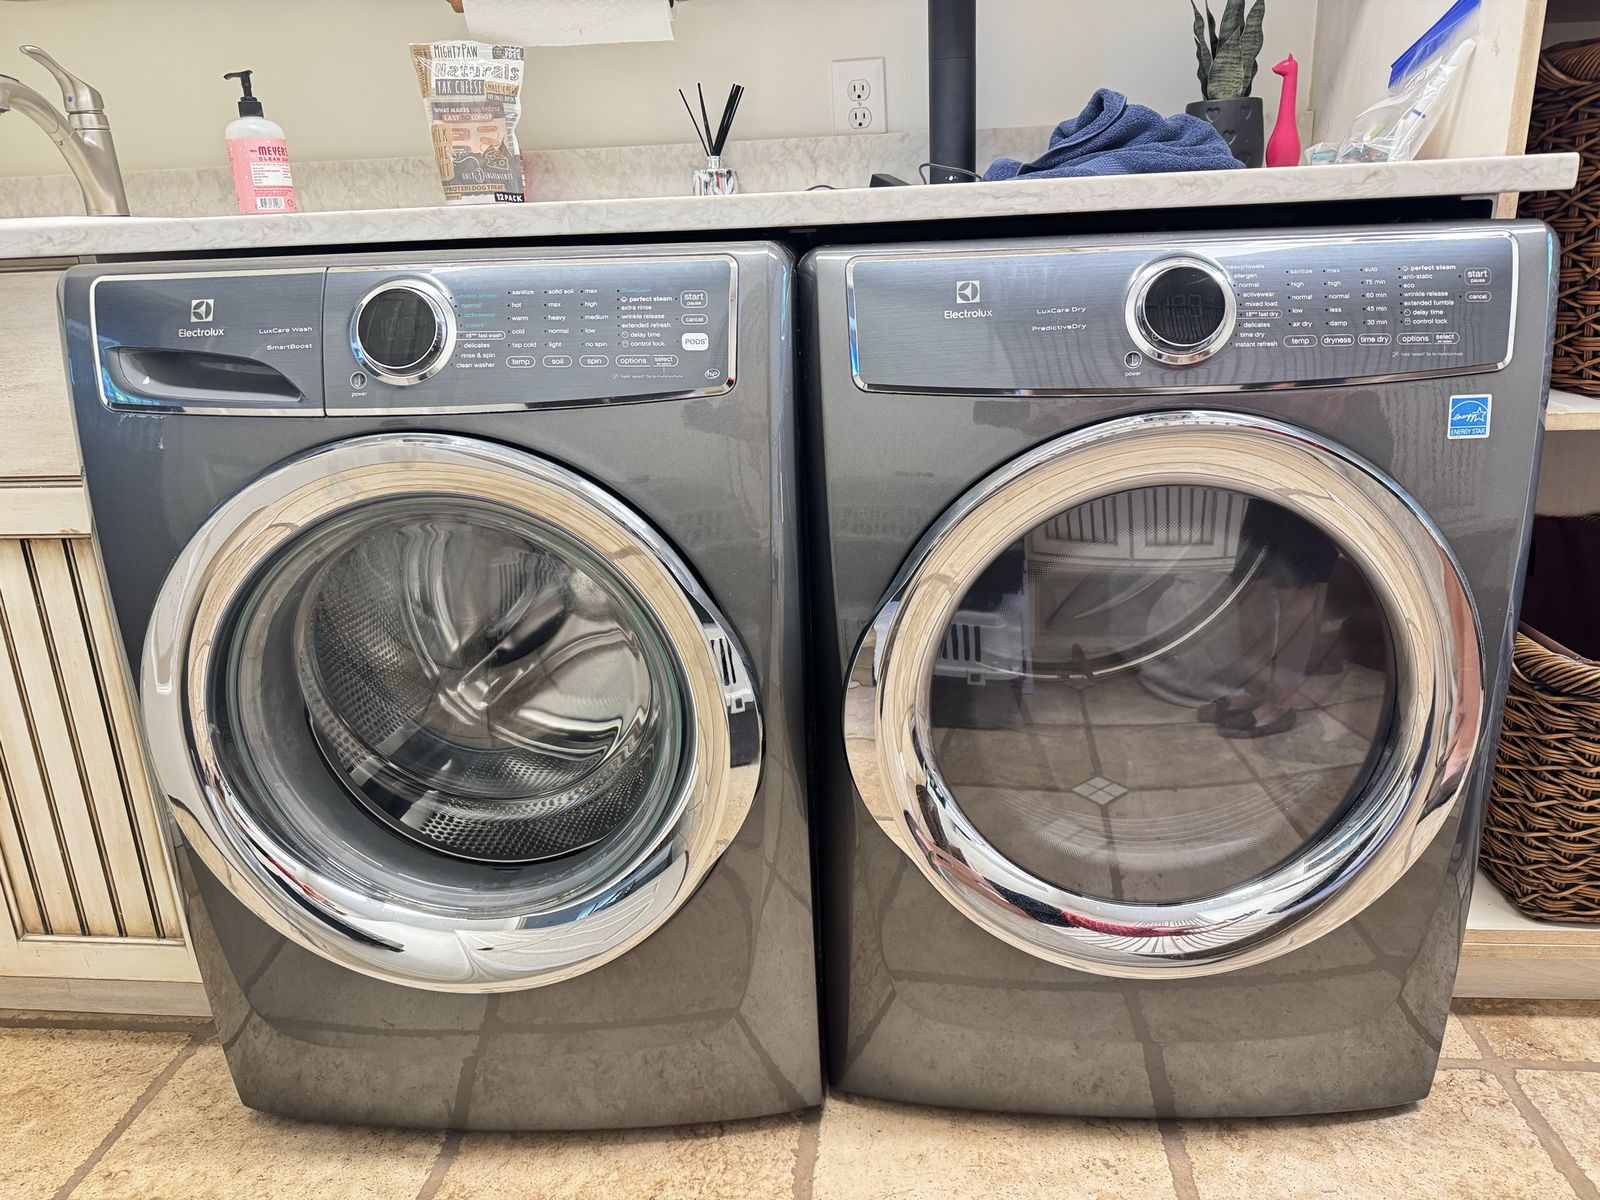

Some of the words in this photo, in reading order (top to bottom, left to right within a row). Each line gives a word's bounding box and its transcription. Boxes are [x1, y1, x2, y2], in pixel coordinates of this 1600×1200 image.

[437, 80, 452, 94] YAK
[455, 80, 483, 94] CHEESE
[1467, 269, 1488, 278] start
[684, 292, 704, 301] start
[585, 301, 598, 309] high
[944, 308, 993, 319] Electrolux
[1071, 306, 1087, 314] Dry
[1412, 309, 1429, 317] delay
[548, 314, 566, 322] heavy
[585, 313, 609, 321] medium
[1031, 323, 1087, 332] PredictiveDry
[1302, 320, 1313, 328] dry
[1329, 320, 1348, 328] damp
[178, 328, 225, 338] Electrolux
[630, 331, 646, 339] delay
[1291, 336, 1310, 346] temp
[1323, 336, 1352, 345] dryness
[1360, 335, 1376, 343] time
[1377, 335, 1389, 344] dry
[266, 343, 313, 351] SmartBoost
[549, 341, 562, 349] light
[596, 341, 608, 349] spin
[512, 358, 530, 367] temp
[551, 357, 564, 365] soil
[586, 357, 602, 366] spin
[620, 357, 647, 365] options
[1450, 428, 1471, 436] ENERGY
